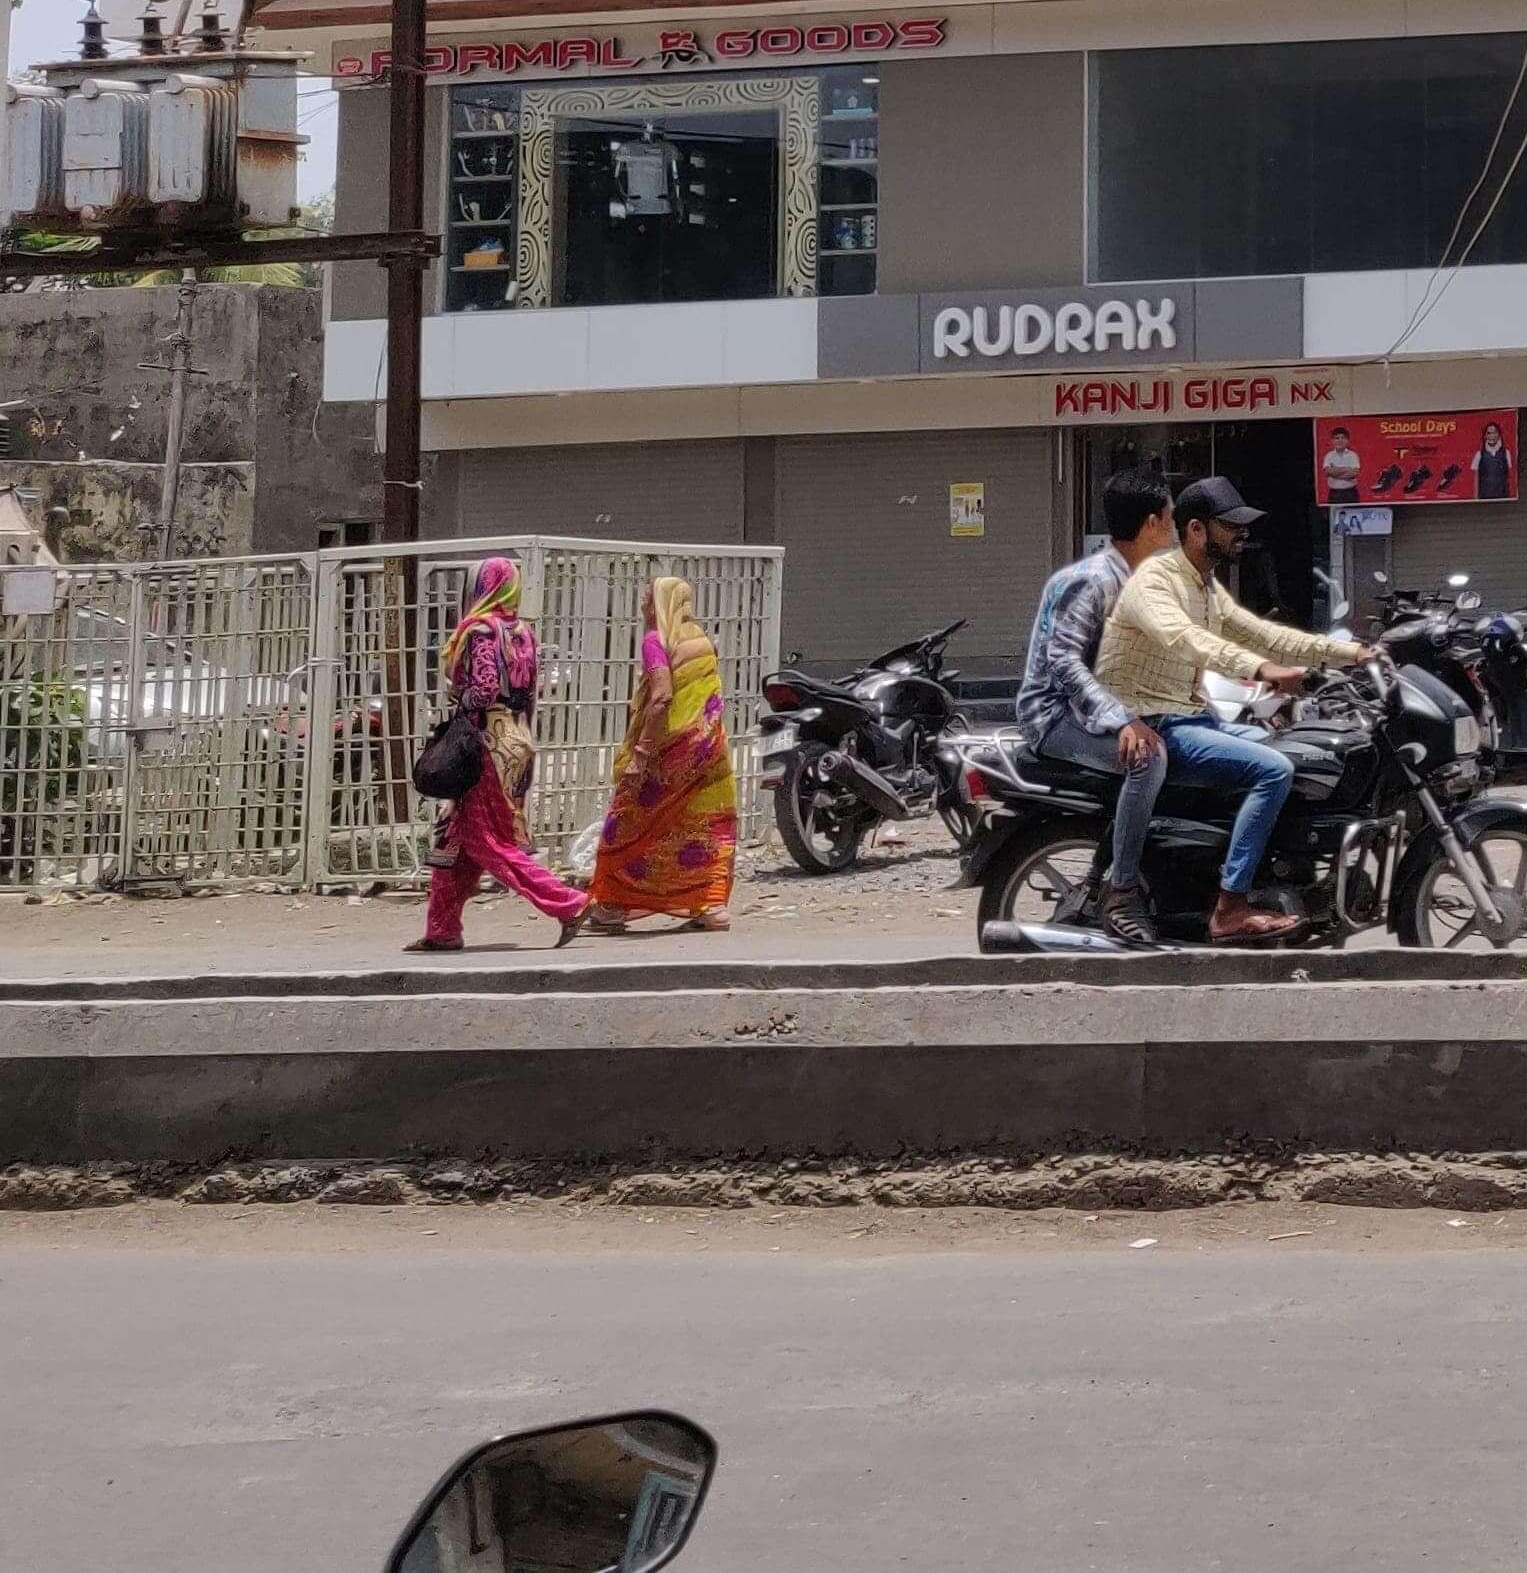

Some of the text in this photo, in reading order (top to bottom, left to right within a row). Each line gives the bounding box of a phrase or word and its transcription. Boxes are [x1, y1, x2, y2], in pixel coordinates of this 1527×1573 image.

[713, 16, 951, 59] GOODS
[933, 297, 1177, 358] RUDRAX
[1055, 376, 1335, 417] KANJI GIGA NX
[1379, 418, 1457, 435] School Days
